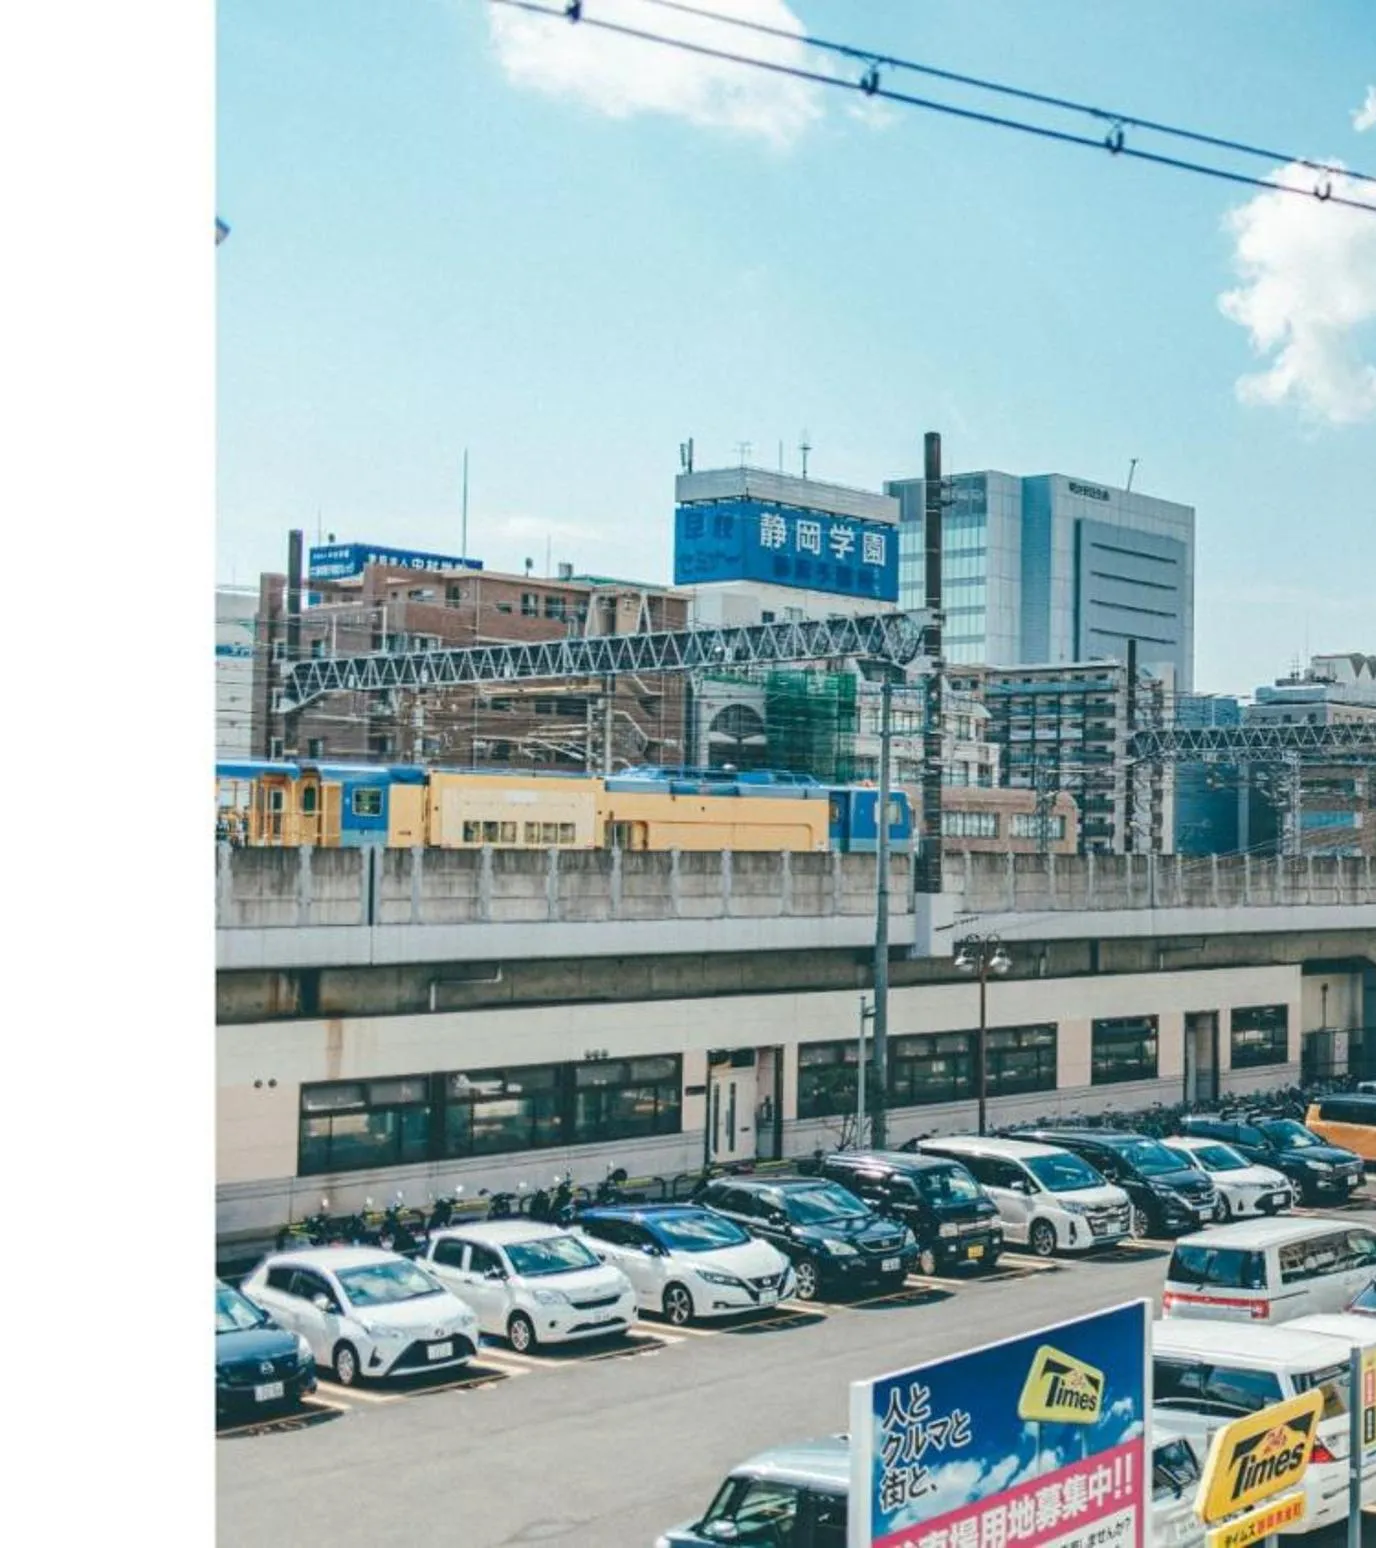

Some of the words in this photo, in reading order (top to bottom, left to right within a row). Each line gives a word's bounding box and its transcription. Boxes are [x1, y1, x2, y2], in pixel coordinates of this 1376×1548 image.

[759, 512, 886, 567] 静岡学園
[882, 1382, 931, 1432] 人と
[1041, 1358, 1100, 1411] Times
[881, 1409, 972, 1467] クルマと
[1228, 1430, 1307, 1500] Times
[896, 1453, 1133, 1548] 場用地募集中!!
